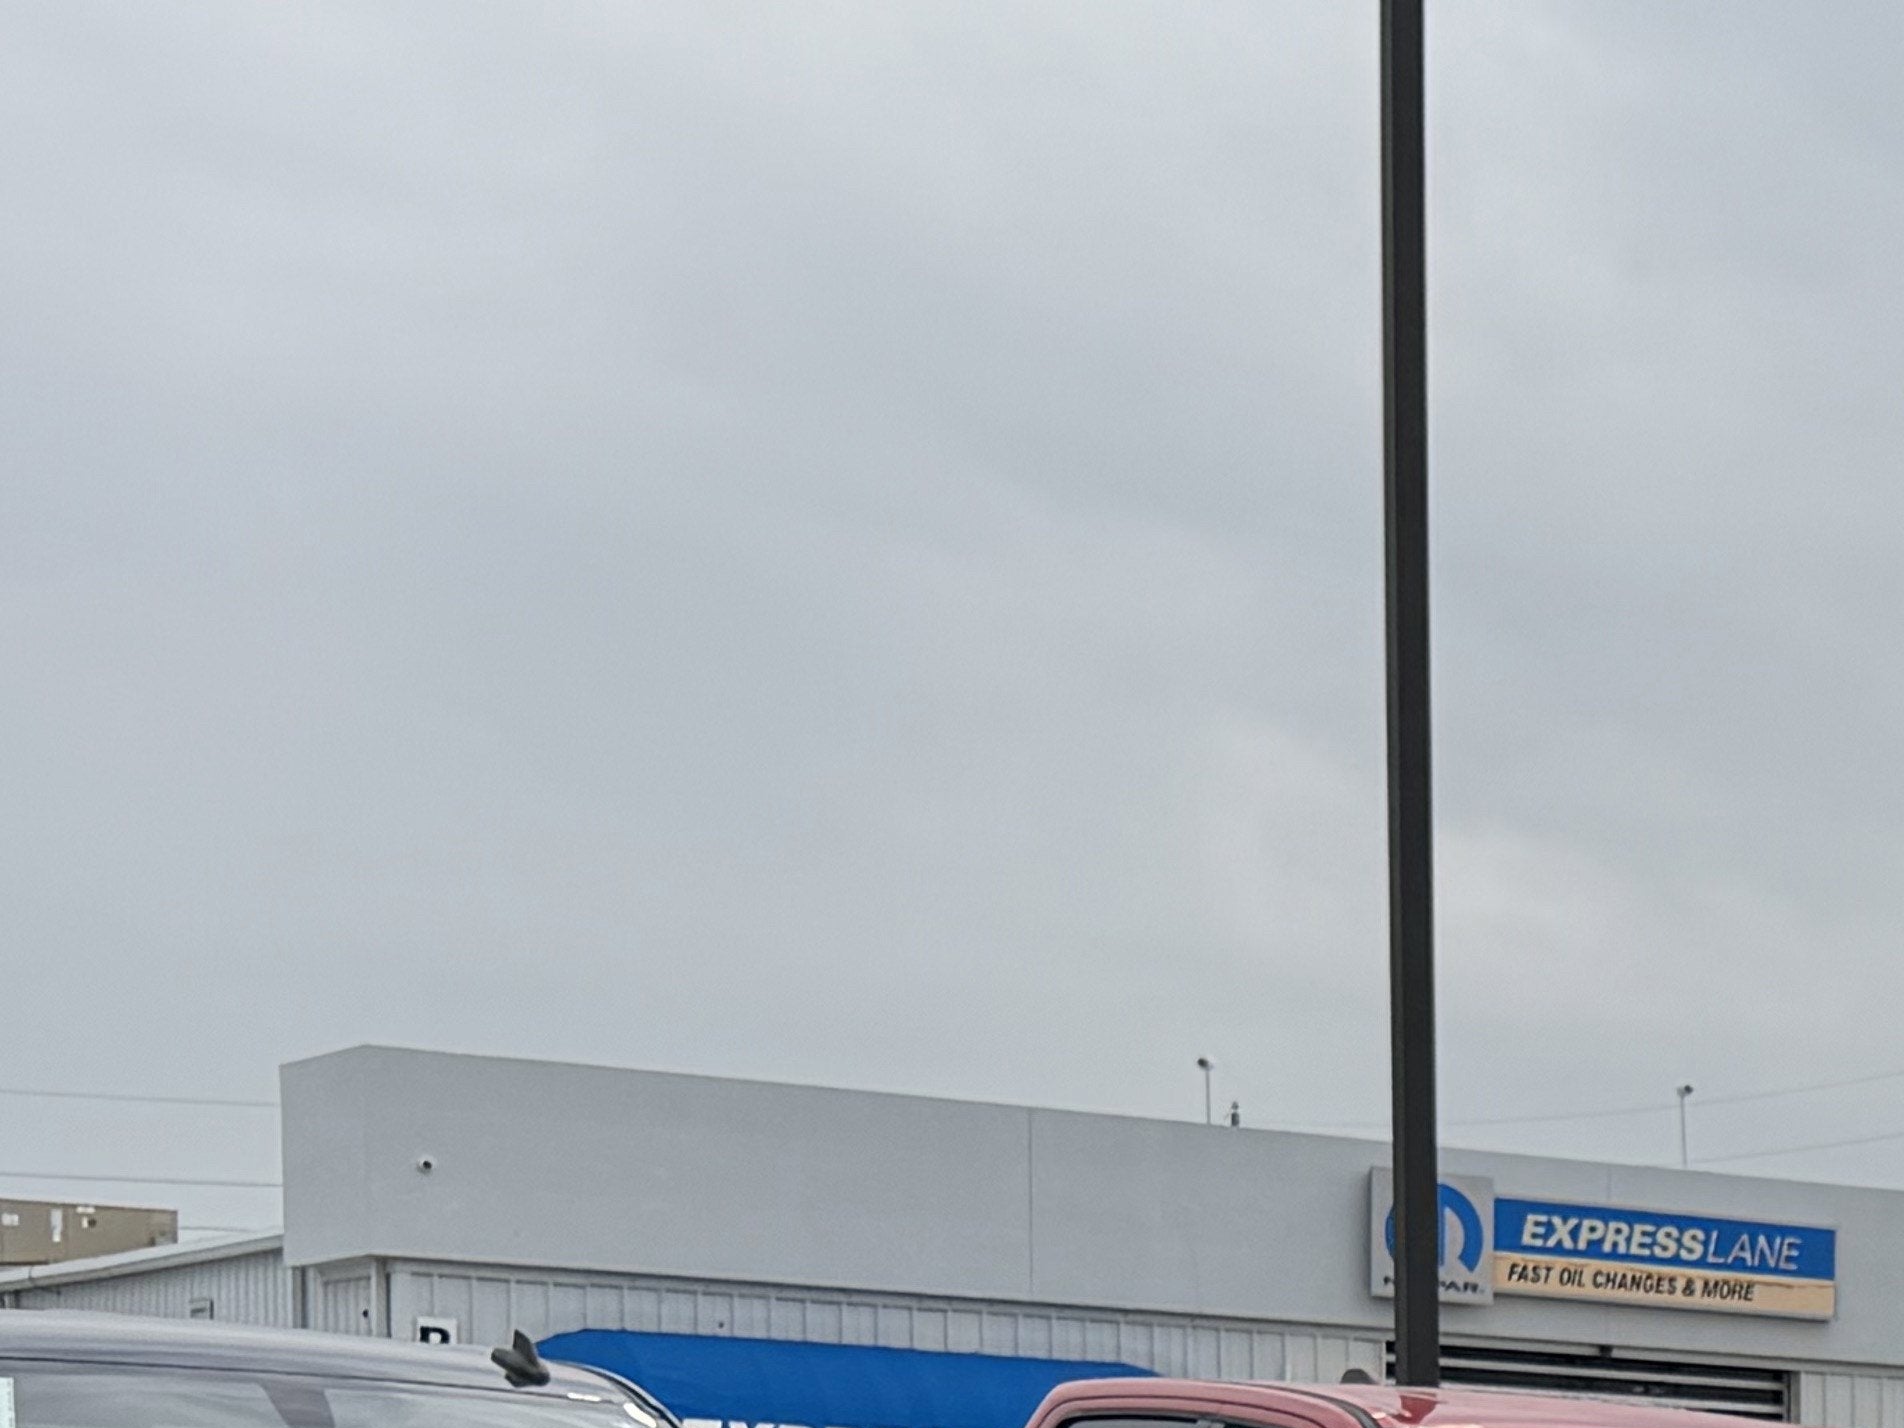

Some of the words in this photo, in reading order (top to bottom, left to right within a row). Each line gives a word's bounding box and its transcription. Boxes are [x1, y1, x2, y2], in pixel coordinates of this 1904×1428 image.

[1507, 1262, 1554, 1285] FAST
[1559, 1268, 1586, 1288] OIL
[1592, 1270, 1678, 1296] CHANGES
[1682, 1278, 1696, 1296] &
[1700, 1279, 1756, 1302] MORE
